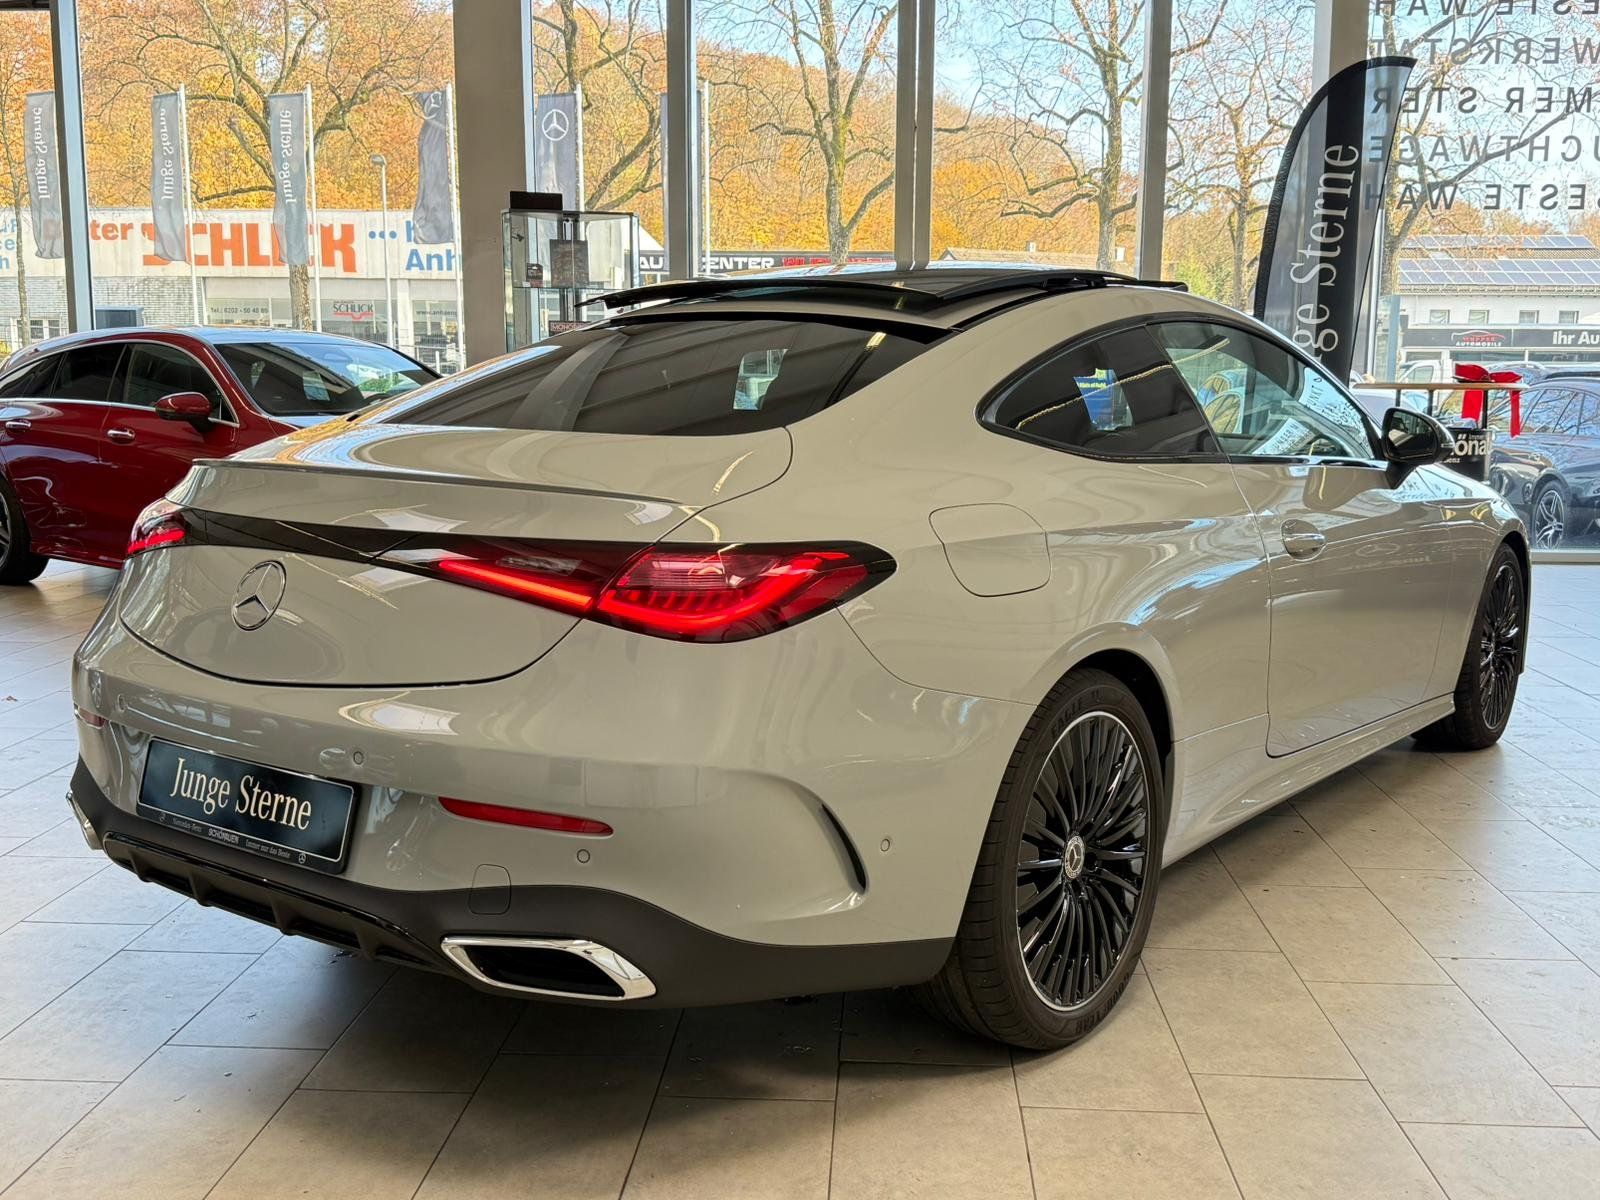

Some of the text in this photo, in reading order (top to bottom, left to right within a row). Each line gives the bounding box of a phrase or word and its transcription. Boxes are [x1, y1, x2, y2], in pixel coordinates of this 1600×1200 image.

[1289, 145, 1360, 287] Sterne
[332, 303, 374, 313] SCHLICK
[1552, 331, 1575, 345] Ihr
[170, 757, 313, 831] Junge Sterne
